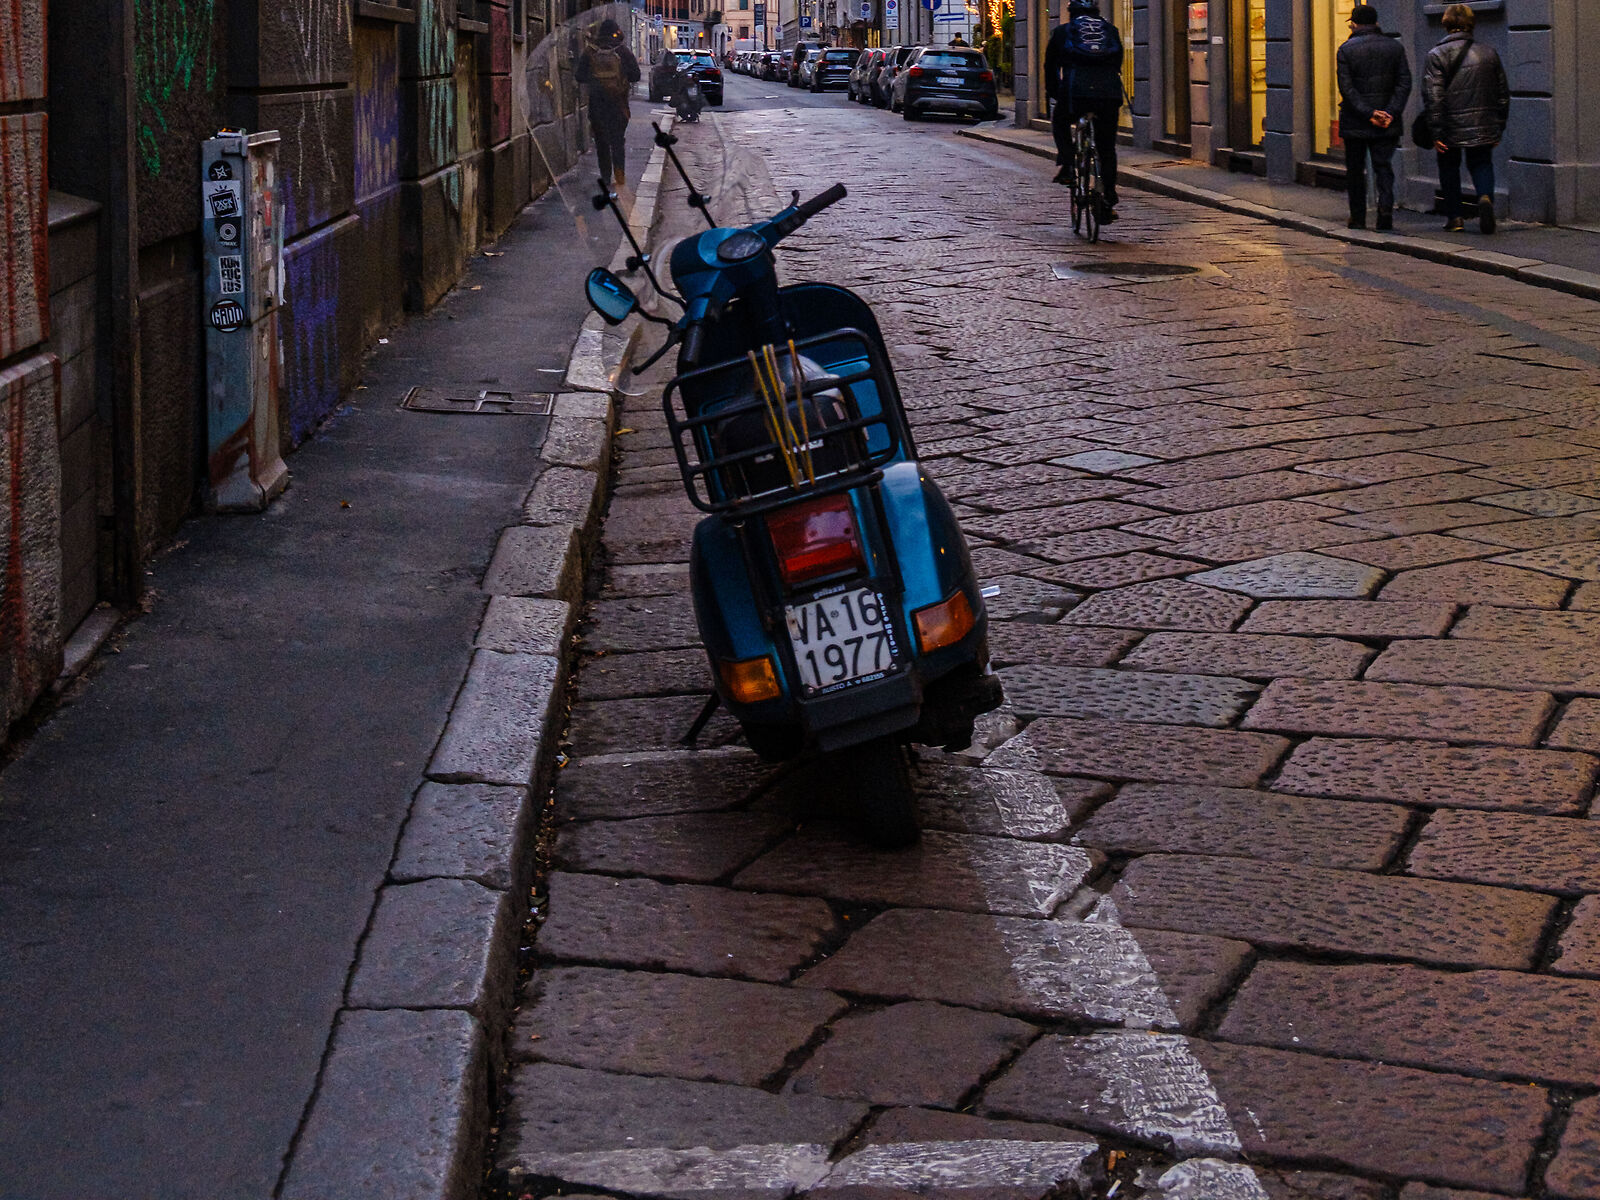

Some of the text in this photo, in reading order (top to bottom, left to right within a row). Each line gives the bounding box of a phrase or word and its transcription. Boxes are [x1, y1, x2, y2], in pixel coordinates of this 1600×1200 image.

[802, 17, 809, 26] P
[796, 589, 882, 645] VA 16
[806, 630, 887, 687] 1977
